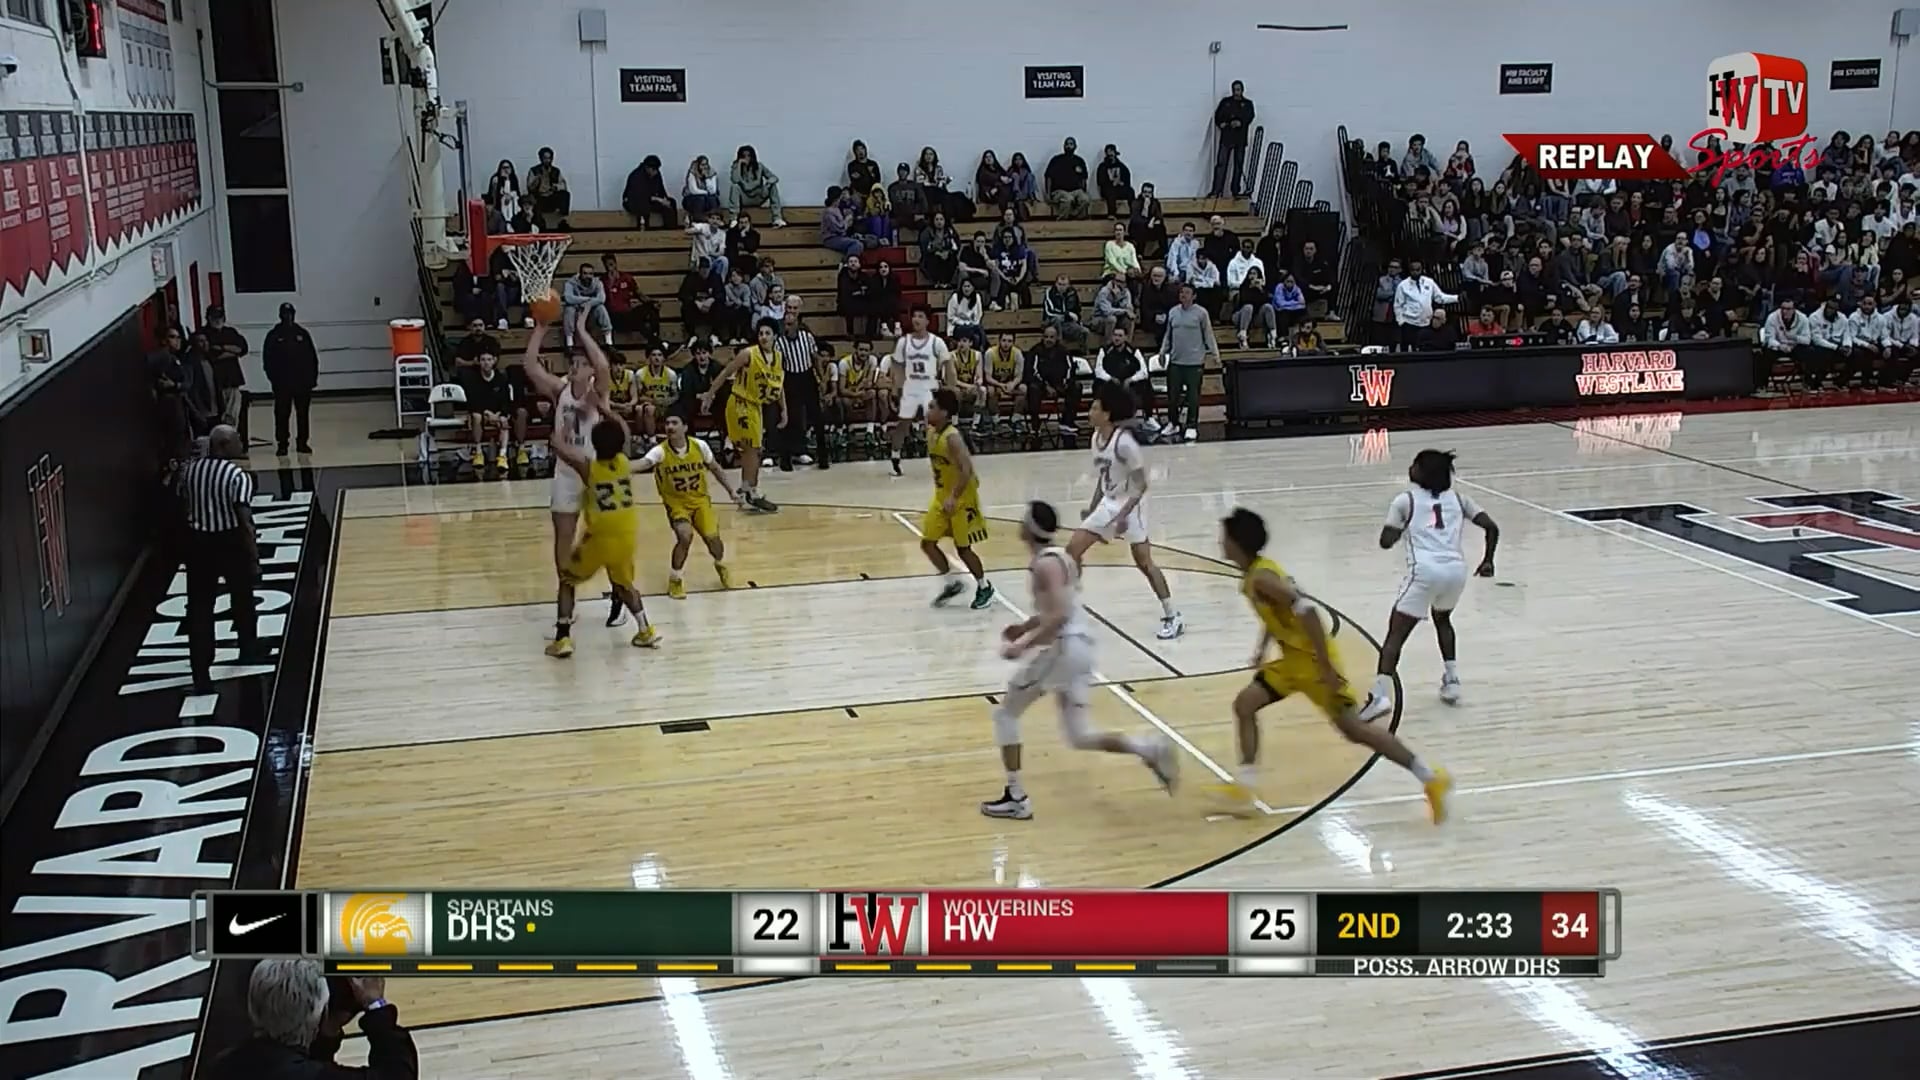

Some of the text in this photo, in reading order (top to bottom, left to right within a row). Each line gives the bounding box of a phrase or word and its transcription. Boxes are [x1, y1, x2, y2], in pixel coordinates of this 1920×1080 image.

[629, 83, 677, 92] TEAM FANS
[633, 74, 672, 83] VISITING
[1582, 351, 1676, 373] HARVARD
[1349, 364, 1394, 407] HW
[1576, 371, 1684, 395] WESTLAKE
[595, 478, 633, 511] 23
[673, 474, 700, 492] 22
[1431, 503, 1446, 530] 1
